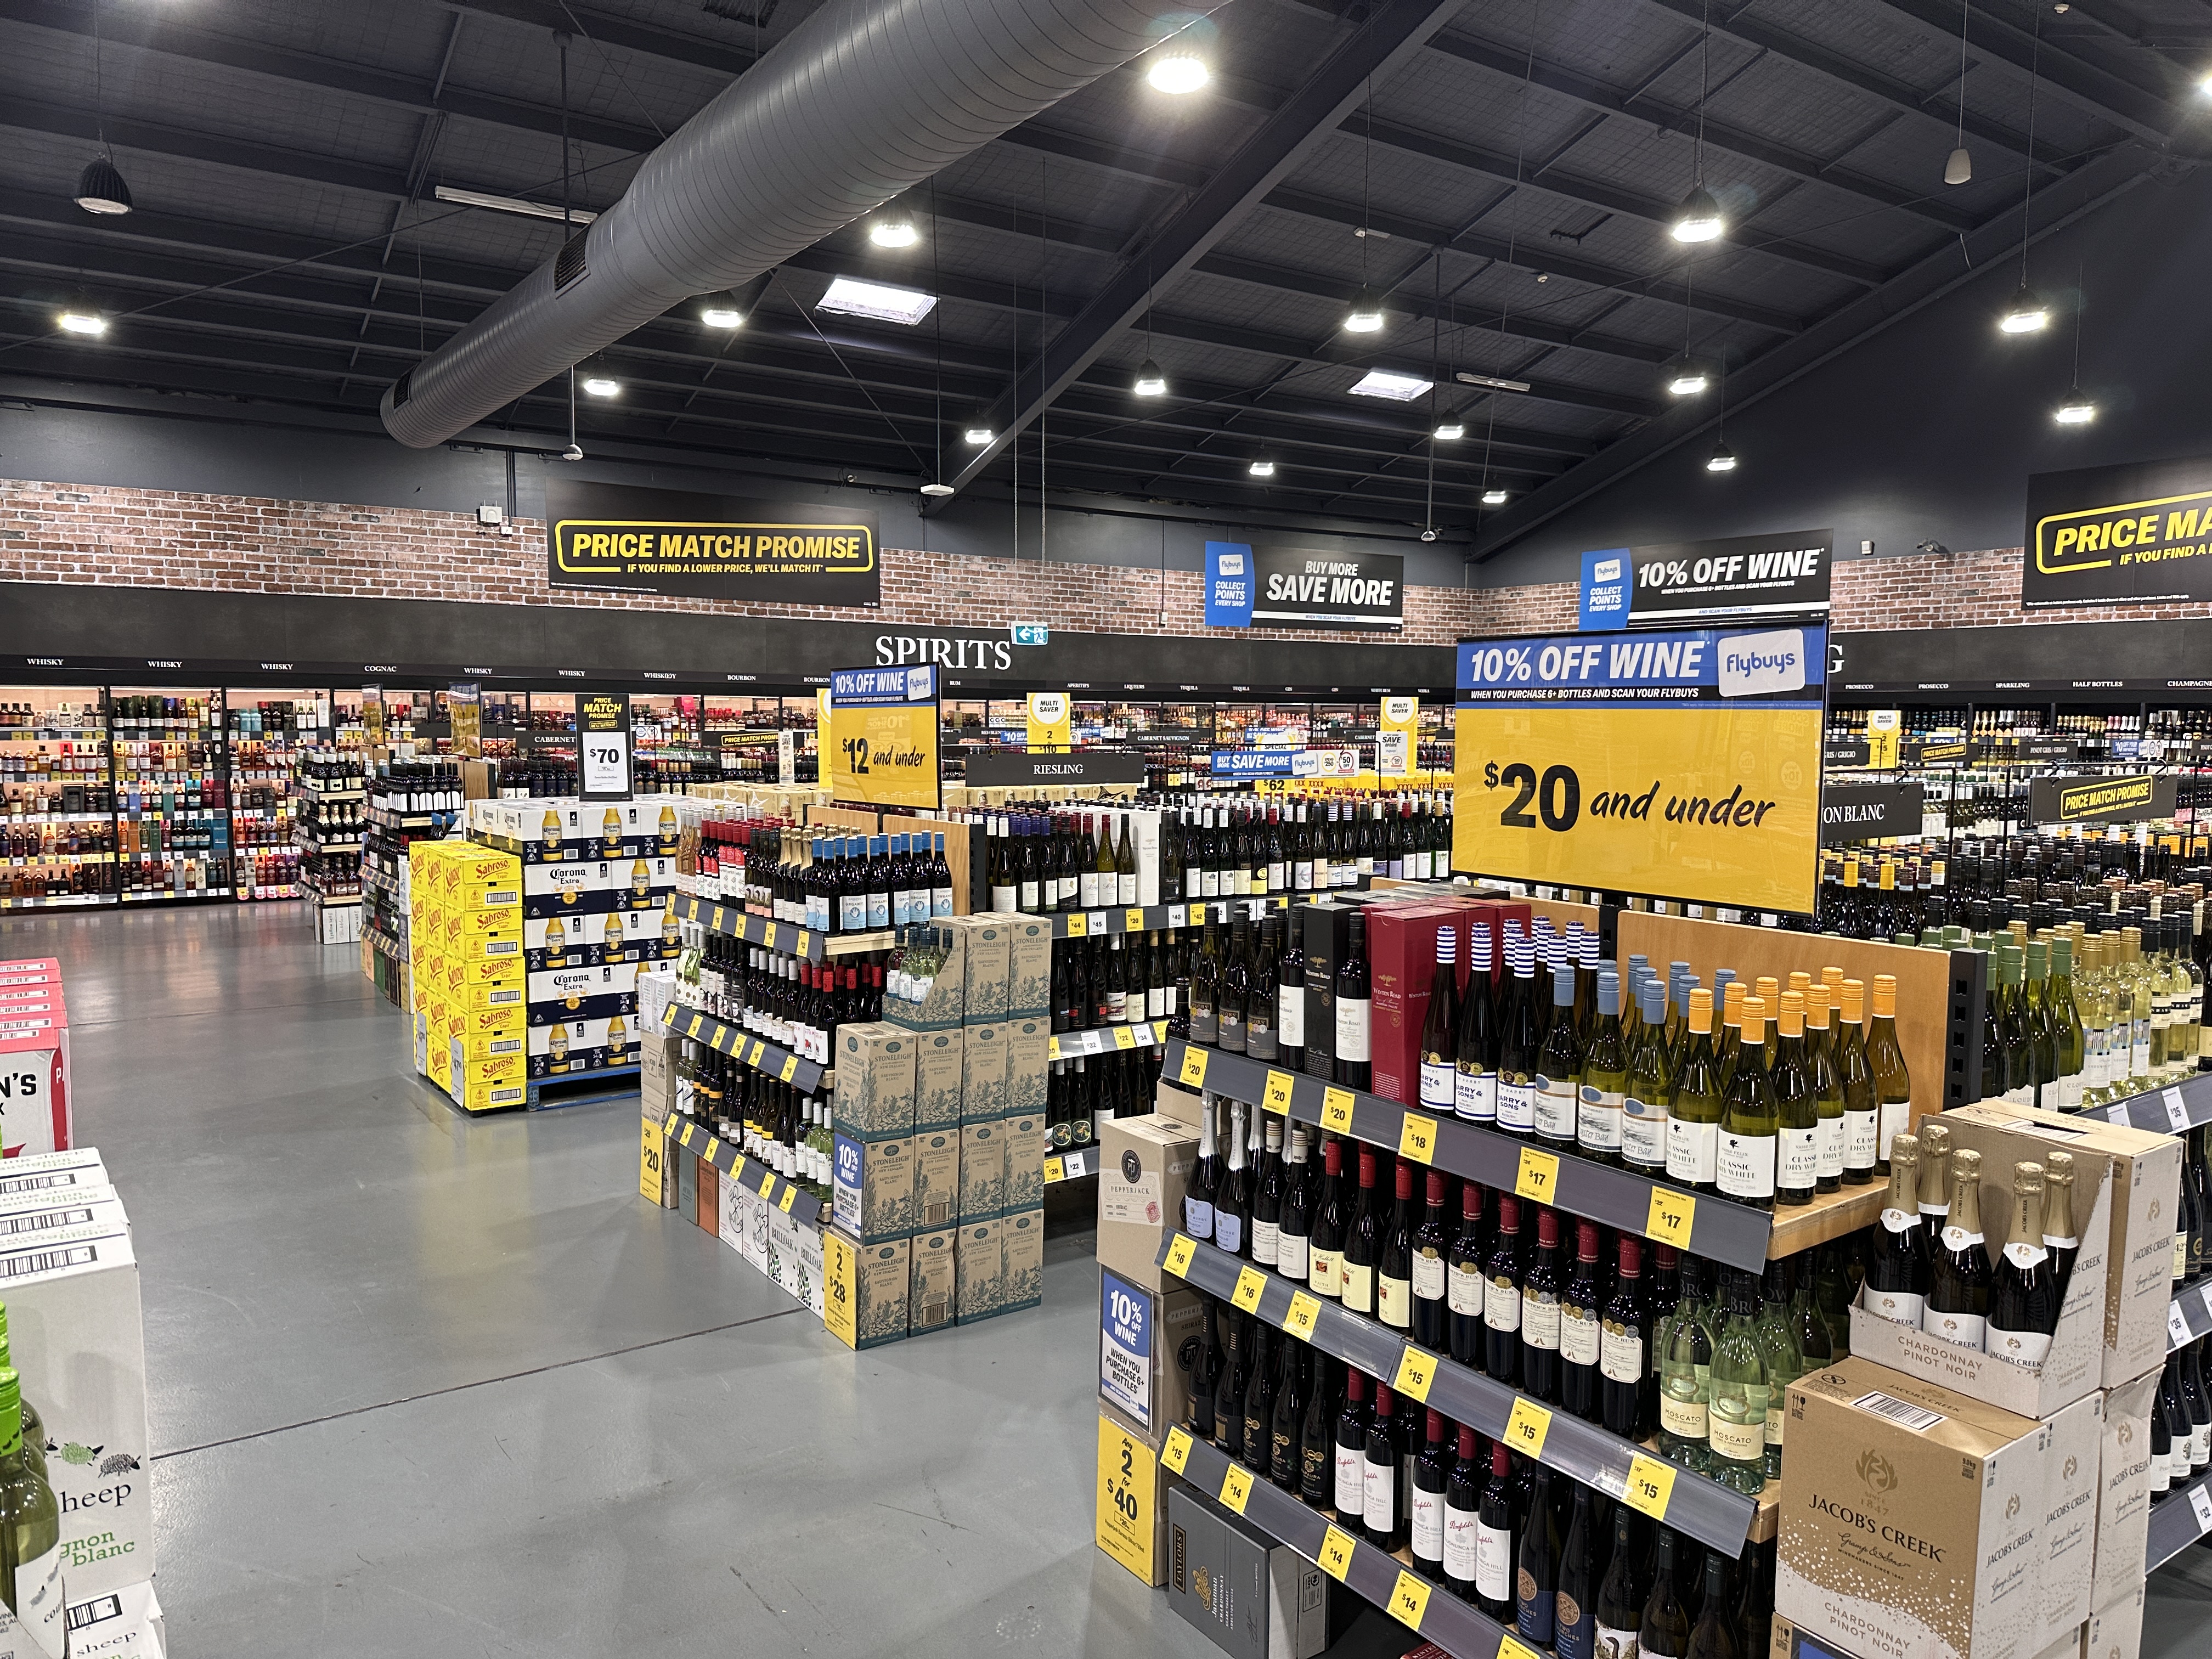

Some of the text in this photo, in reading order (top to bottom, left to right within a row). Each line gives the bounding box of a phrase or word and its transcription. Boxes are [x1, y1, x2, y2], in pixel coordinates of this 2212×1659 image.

[2053, 515, 2159, 556] PRICE
[572, 533, 860, 558] PRICE MATCH PROMISE
[2119, 544, 2206, 566] IF YOU FIND A
[627, 564, 636, 573] IF
[637, 564, 658, 573] YOU
[659, 564, 681, 573] FIND
[682, 564, 690, 573] A
[691, 564, 723, 573] LOWER
[724, 565, 753, 574] PRICE,
[754, 565, 779, 573] WE'LL
[781, 565, 809, 573] MATCH
[1305, 560, 1359, 577] BUY MORE
[1639, 559, 1688, 588] 10%
[1692, 555, 1743, 584] OFF
[1215, 580, 1245, 591] COLLECT
[1266, 573, 1394, 606] SAVE MORE
[1590, 585, 1622, 596] COLLECT
[1215, 590, 1245, 600] POINTS
[1589, 595, 1622, 605] POINTS
[876, 636, 1012, 670] SPIRITS
[1471, 646, 1532, 682] 10%
[1539, 645, 1602, 681] OFF
[644, 672, 676, 680] WHISK(E)Y
[836, 674, 855, 693] 10%
[856, 673, 875, 692] OFF
[1471, 687, 1699, 699] WHEN YOU PURCHASE 6+ BOTTLES AND SCAN YOUR FLYBUYS
[583, 703, 622, 713] MATCH
[589, 748, 619, 764] $70
[842, 737, 926, 774] $12 and under
[1217, 755, 1230, 764] BUY
[1231, 754, 1289, 769] SAVE MORE
[1033, 764, 1083, 774] RIESLING
[1263, 779, 1285, 791] $62
[1483, 760, 1776, 832] $20 and under
[2065, 794, 2089, 810] PRICE
[2089, 788, 2116, 806] MATCH
[2117, 783, 2149, 802] PROMISE
[1844, 804, 1885, 822] BLANC
[550, 869, 586, 879] Corona
[1013, 1034, 1047, 1042] STONELEIGH
[1188, 1064, 1200, 1076] $20
[1271, 1088, 1285, 1102] $20
[1332, 1107, 1346, 1121] $20
[1411, 1135, 1426, 1149] $18
[644, 1146, 659, 1173] $20
[1719, 1158, 1751, 1171] CLASSIC
[841, 1167, 854, 1183] WINE
[1529, 1169, 1545, 1186] $17
[1110, 1186, 1150, 1194] PEPPERJACK
[1661, 1211, 1681, 1229] $17
[771, 1227, 794, 1251] BULLOAK
[837, 1252, 843, 1272] 2
[1174, 1251, 1185, 1263] $16
[830, 1276, 846, 1304] $28
[1110, 1290, 1142, 1325] 10%
[1181, 1321, 1201, 1331] SHIRAZ
[1296, 1311, 1308, 1325] $15
[1115, 1321, 1137, 1347] WINE
[1131, 1321, 1142, 1333] OFF
[1110, 1347, 1141, 1374] WHEN YOU
[1898, 1335, 1983, 1371] CHARDONNAY
[1106, 1355, 1145, 1386] PURCHASE 6+
[1904, 1348, 1976, 1380] PINOT NOIR
[1408, 1368, 1424, 1385] $15
[1665, 1408, 1701, 1423] MOSCATO
[1519, 1420, 1535, 1440] $15
[1122, 1437, 1133, 1452] Any
[1172, 1446, 1182, 1460] $15
[1121, 1449, 1132, 1478] 2
[1122, 1476, 1131, 1487] for
[59, 1483, 132, 1514] heep
[1107, 1477, 1137, 1521] $40
[1230, 1483, 1242, 1499] $14
[1808, 1493, 1946, 1563] JACOB'S CREEK
[72, 1541, 135, 1567] blanc
[1838, 1548, 1905, 1581] WINEMAKERS SINCE 1847
[1402, 1594, 1417, 1612] $14
[1824, 1601, 1910, 1650] CHARDONNAY
[77, 1631, 137, 1658] sheep
[1830, 1616, 1903, 1658] PINOT NOIR
